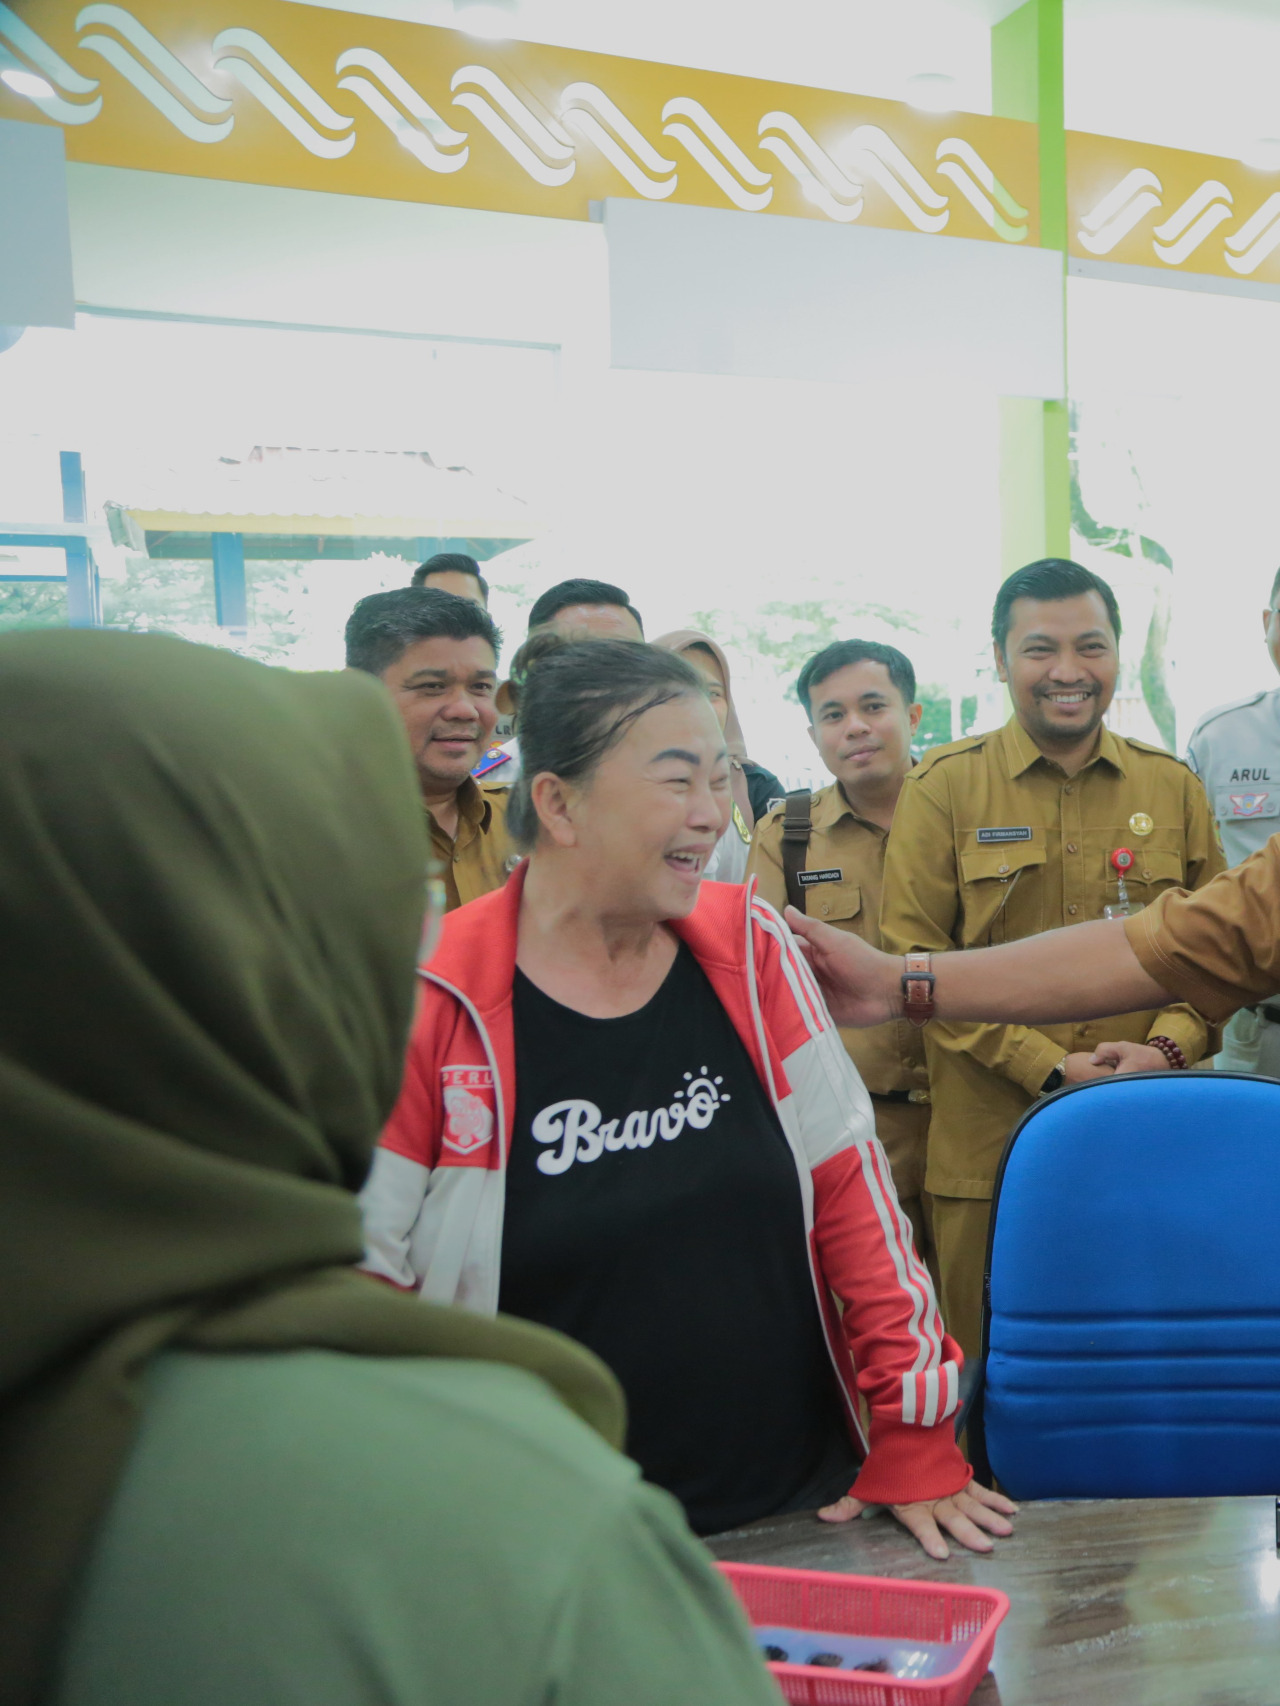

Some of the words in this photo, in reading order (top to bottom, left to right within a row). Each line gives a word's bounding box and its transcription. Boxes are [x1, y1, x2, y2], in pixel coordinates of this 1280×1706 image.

[1229, 768, 1272, 782] ARUL
[442, 1071, 493, 1085] PERU
[531, 1077, 722, 1176] Bravo
